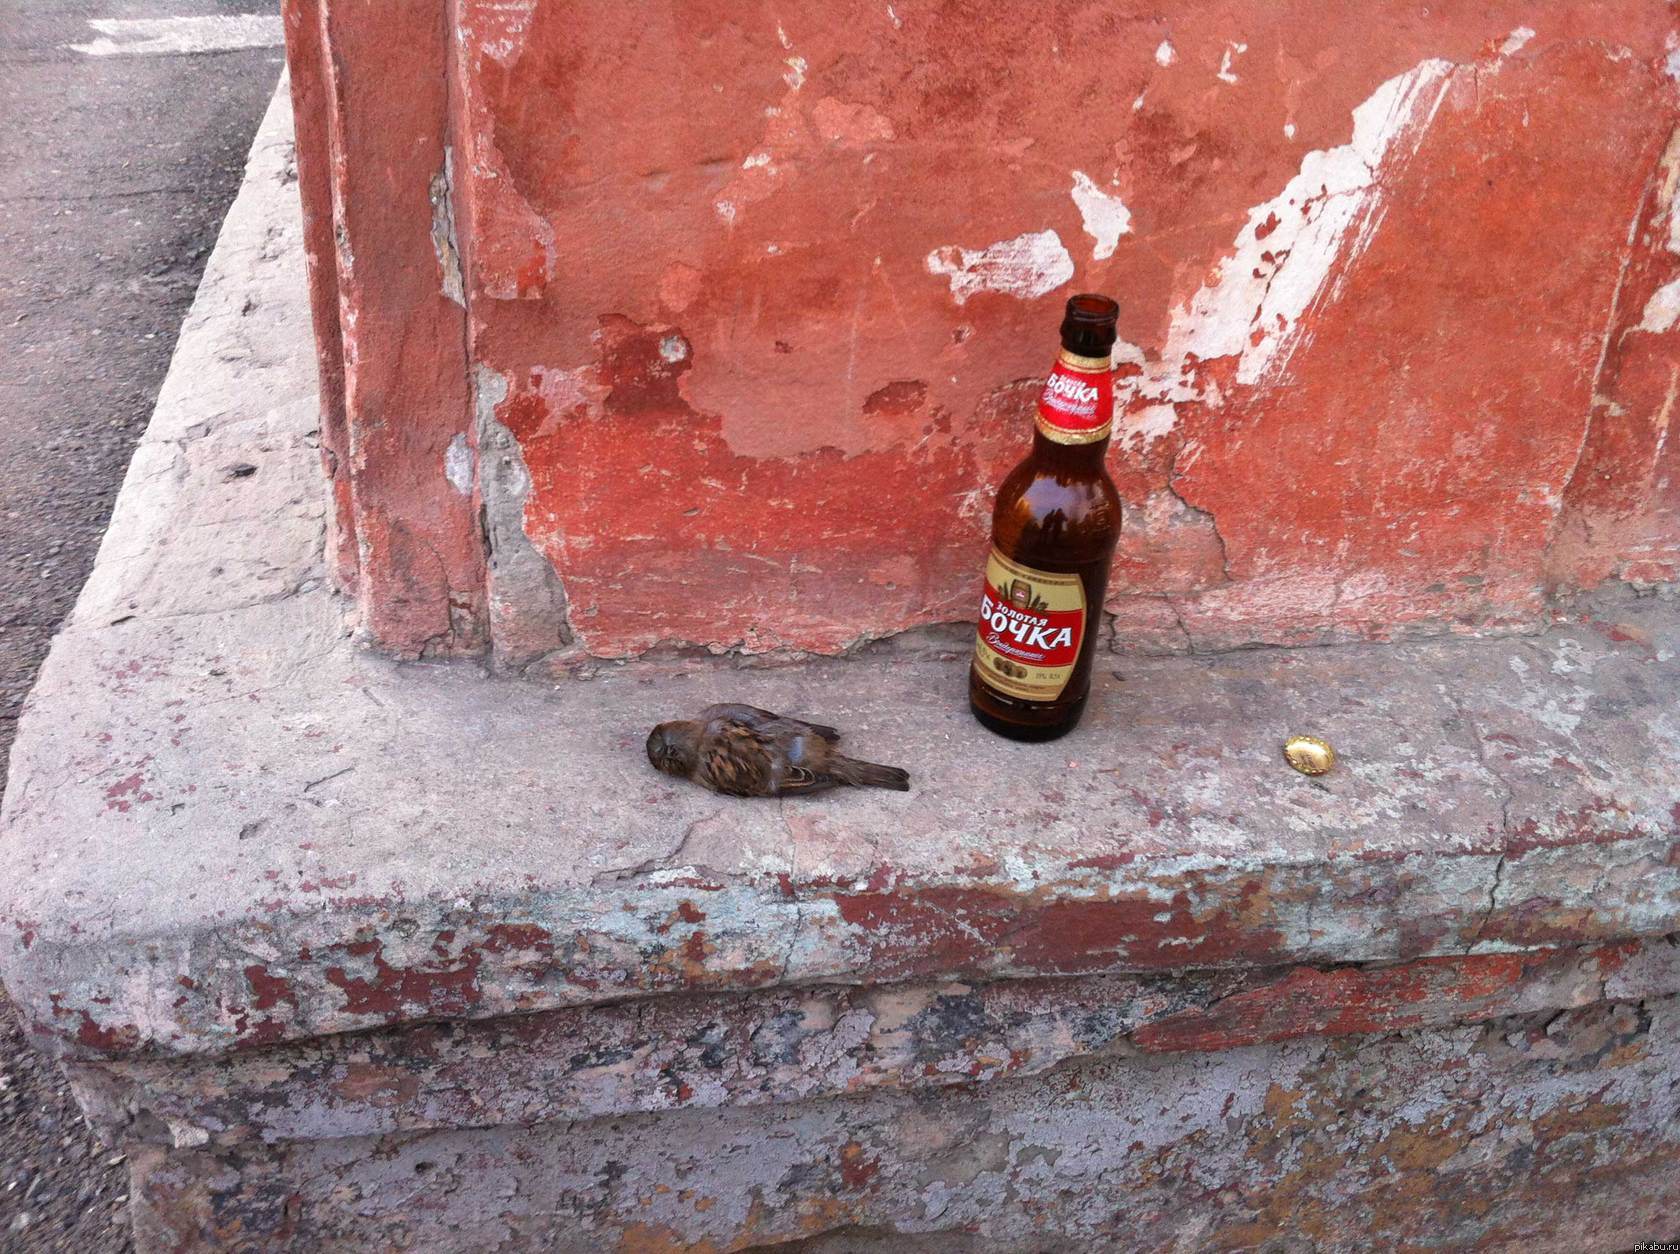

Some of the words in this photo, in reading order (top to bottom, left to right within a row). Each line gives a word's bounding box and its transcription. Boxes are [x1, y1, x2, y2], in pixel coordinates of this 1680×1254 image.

[1046, 373, 1098, 402] БОЧКА
[981, 594, 1072, 649] БОЧКА
[996, 601, 1048, 627] ЗОЛОТАЯ
